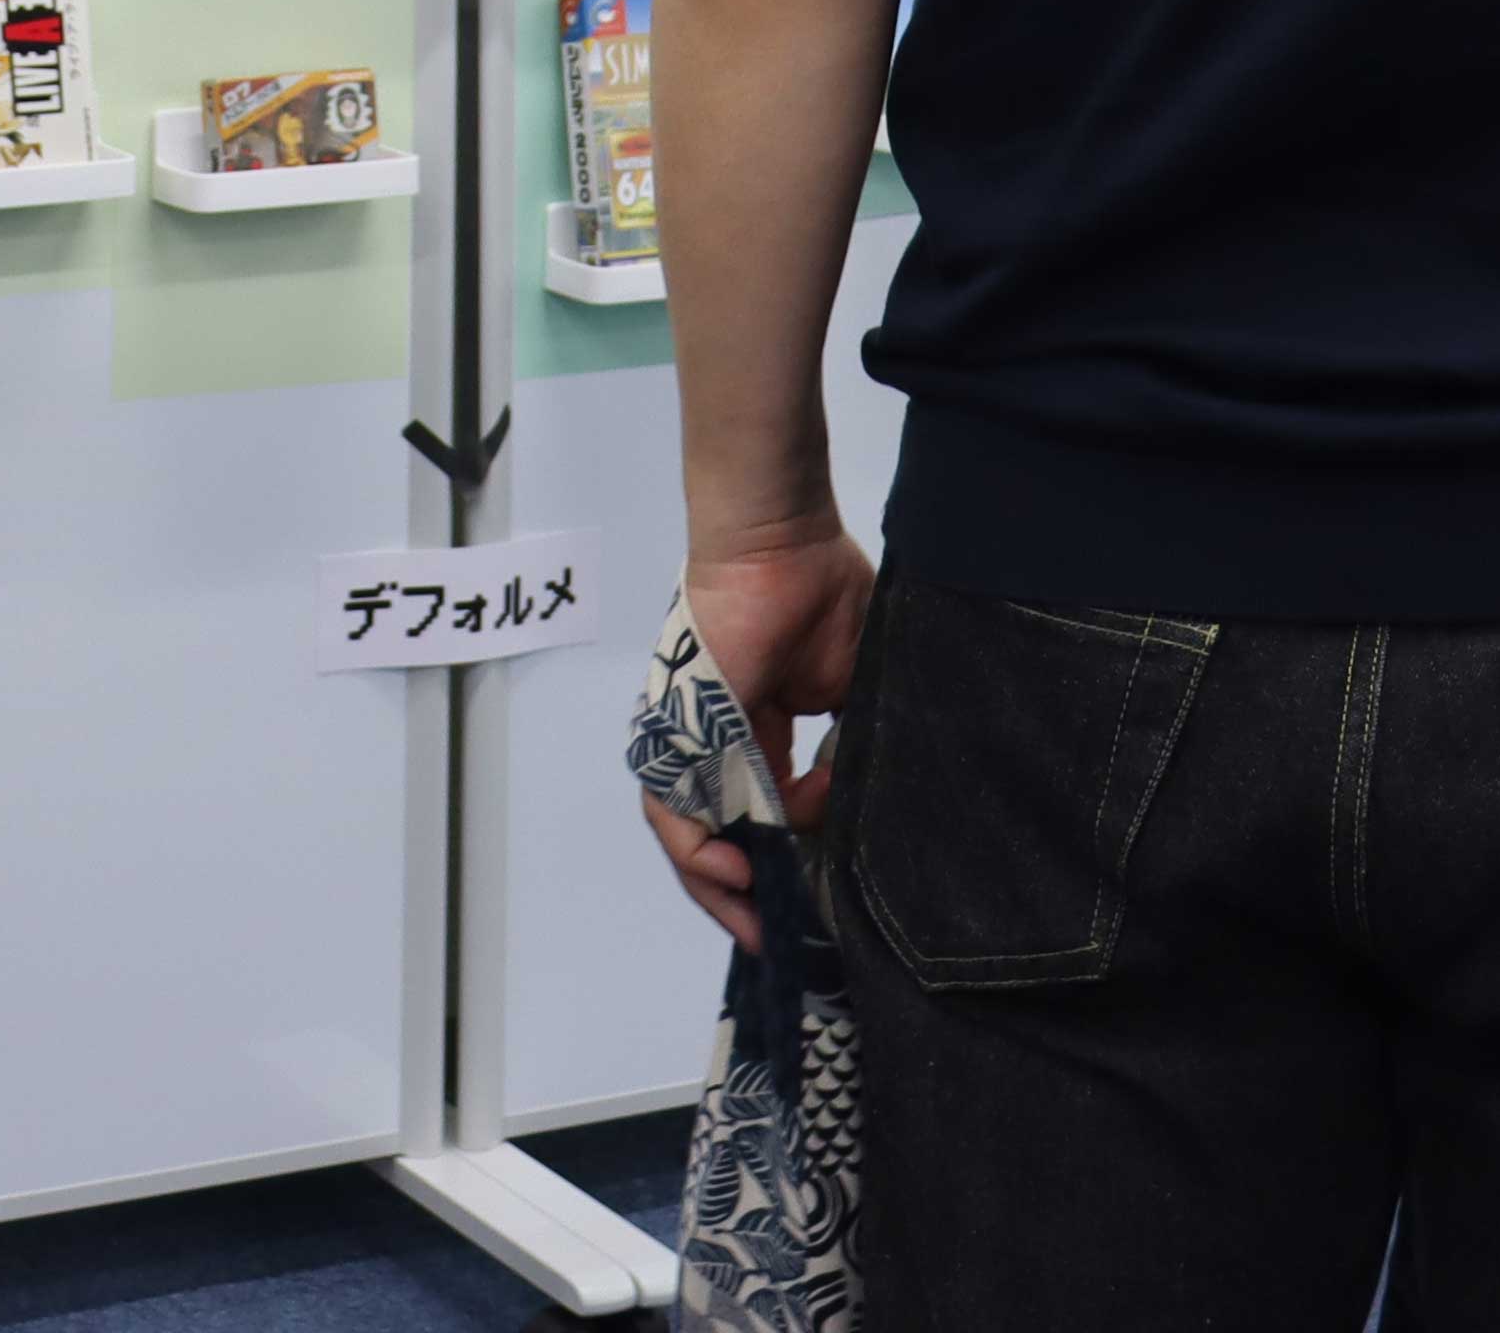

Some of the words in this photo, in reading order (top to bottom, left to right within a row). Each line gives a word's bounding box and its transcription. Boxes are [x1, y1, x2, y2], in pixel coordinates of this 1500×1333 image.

[343, 566, 576, 641] デフォルメ
